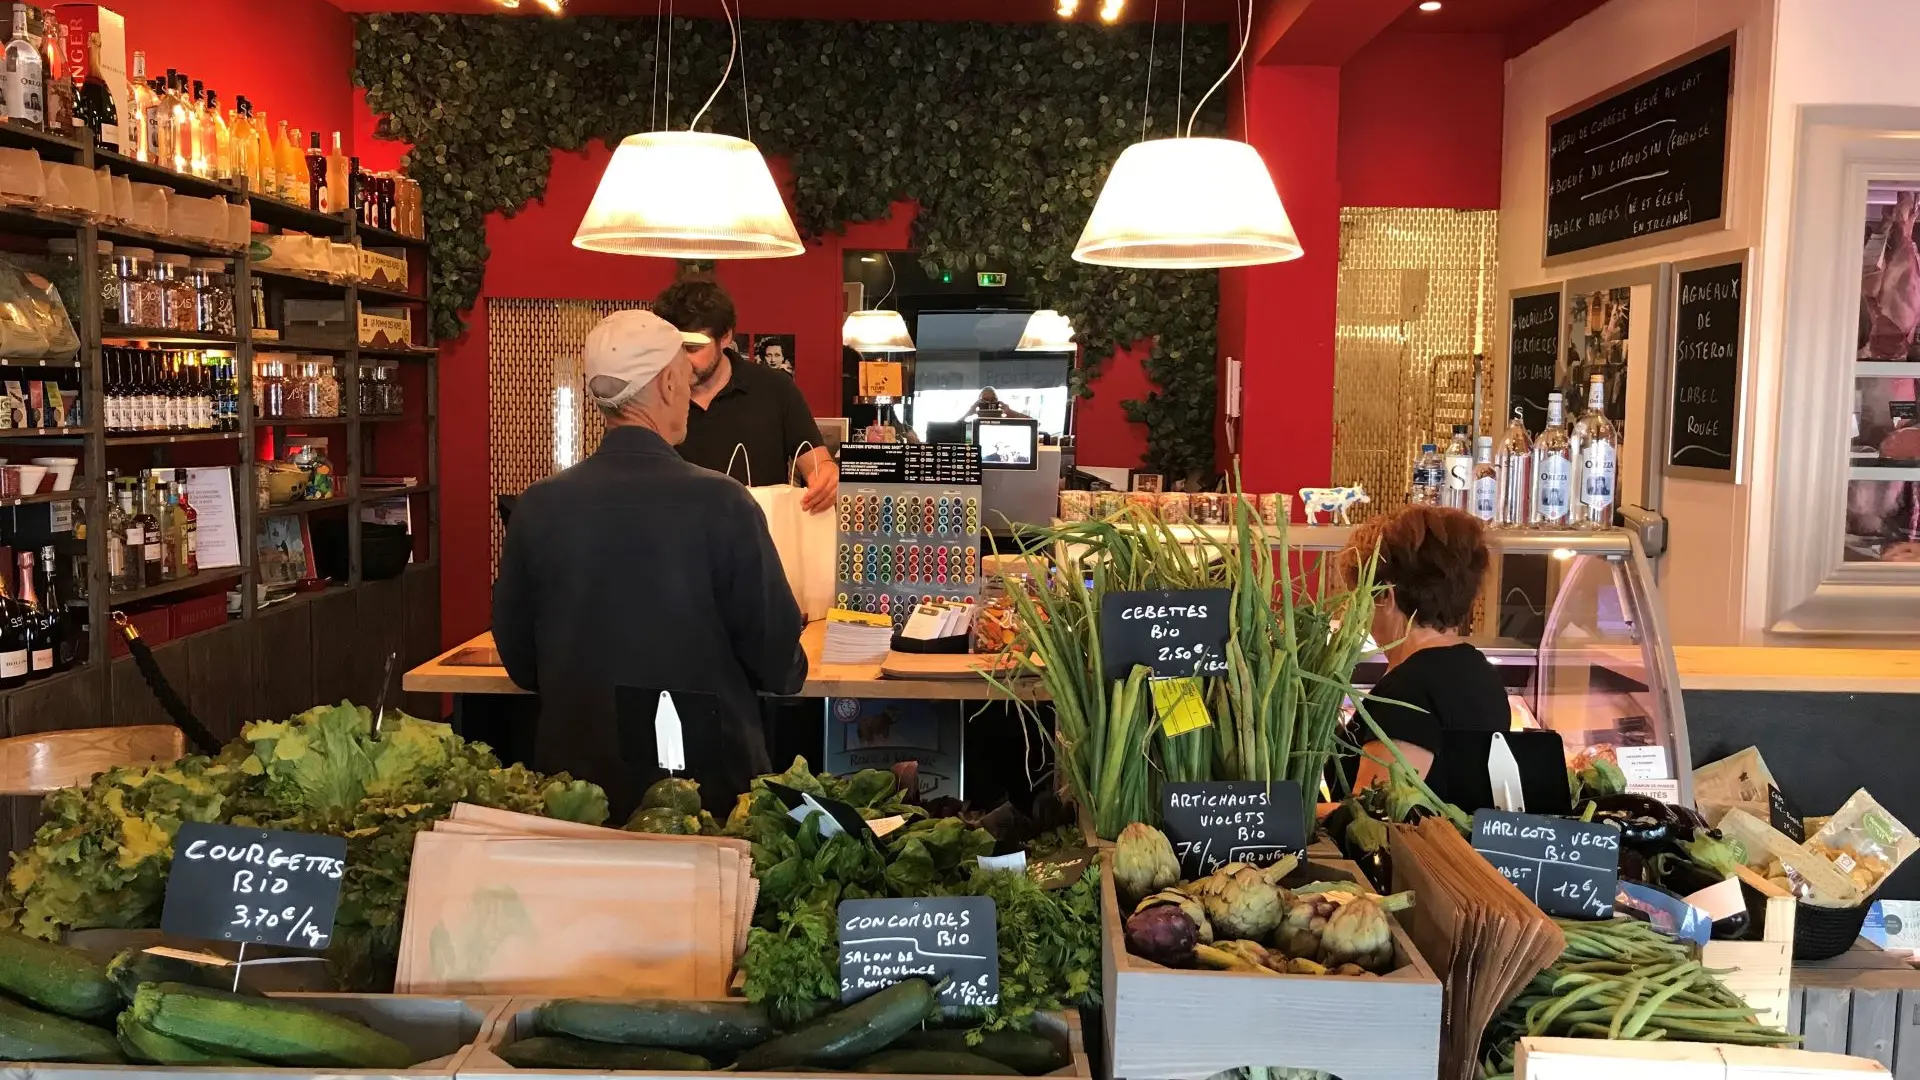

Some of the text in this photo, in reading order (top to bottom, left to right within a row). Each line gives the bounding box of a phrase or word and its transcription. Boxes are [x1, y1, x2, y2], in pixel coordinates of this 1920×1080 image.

[1579, 126, 1588, 140] DE
[1665, 86, 1677, 98] AU
[1681, 73, 1702, 91] LAIT
[1556, 168, 1584, 194] BOEUF
[1592, 164, 1603, 178] DU
[1610, 140, 1662, 174] LIMOUSIN
[1554, 217, 1582, 239] BLACK
[1642, 197, 1652, 212] ET
[1633, 221, 1644, 234] EN
[1682, 279, 1738, 305] AGNEAUX
[1698, 311, 1711, 330] DE
[1678, 336, 1734, 362] SISTERON
[1530, 364, 1555, 380] LANDE
[1680, 387, 1718, 404] LABEL
[1688, 415, 1719, 436] ROUGE
[1585, 460, 1614, 468] OZZA
[1121, 604, 1208, 620] CEBETTES
[1150, 620, 1180, 638] BIO
[1170, 790, 1267, 808] ARTICHAUTS
[1200, 810, 1264, 826] VIOLETS
[1238, 825, 1266, 841] BIO
[1482, 818, 1618, 850] HARICOTS VERTS
[185, 840, 344, 878] COURGETTES
[1544, 844, 1580, 862] BIO
[233, 870, 288, 894] BIO
[845, 910, 970, 931] CONCOMBRES
[937, 926, 970, 946] BIO
[844, 951, 914, 964] SALON DE
[864, 964, 936, 976] PROVENCE
